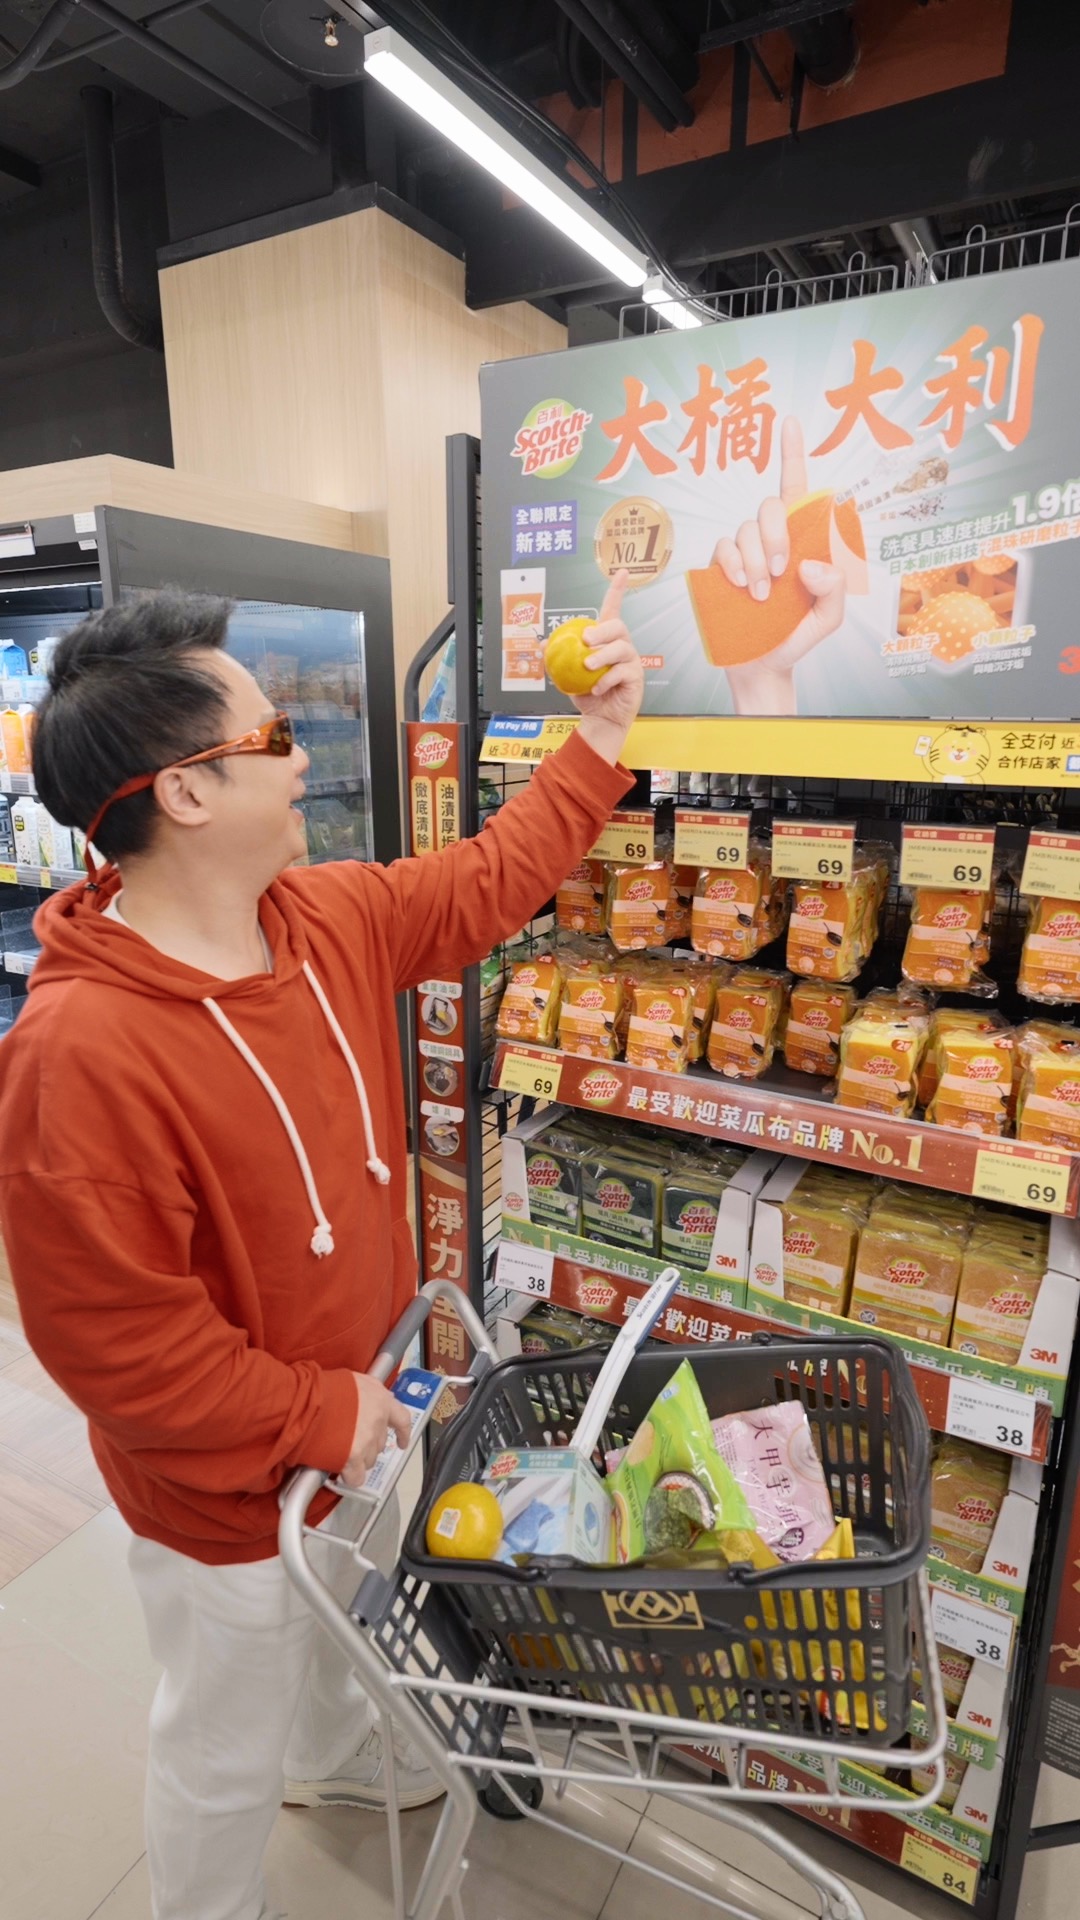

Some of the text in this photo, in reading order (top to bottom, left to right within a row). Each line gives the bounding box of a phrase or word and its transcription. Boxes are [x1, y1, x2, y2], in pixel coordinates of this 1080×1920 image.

[523, 434, 580, 474] Brite
[515, 505, 572, 525] 全聯限定
[1001, 732, 1057, 750] 全支付
[420, 750, 447, 764] Brite
[998, 756, 1061, 770] 合作店家
[625, 843, 647, 858] 69
[716, 846, 740, 862] 69
[817, 858, 843, 875] 69
[953, 865, 982, 882] 69
[533, 1078, 553, 1094] 69
[583, 1088, 614, 1101] Brite
[627, 1084, 924, 1174] 最受歡迎菜瓜布品牌 No.1
[1026, 1183, 1056, 1203] 69
[715, 1254, 737, 1269] 3M
[527, 1276, 546, 1292] 38
[582, 1294, 610, 1305] Brite
[1029, 1348, 1058, 1364] 3M
[995, 1425, 1023, 1446] 38
[992, 1560, 1019, 1578] 3M
[975, 1639, 1001, 1661] 38
[966, 1710, 993, 1728] 3M
[964, 1805, 988, 1824] 3M
[941, 1871, 967, 1895] 84
